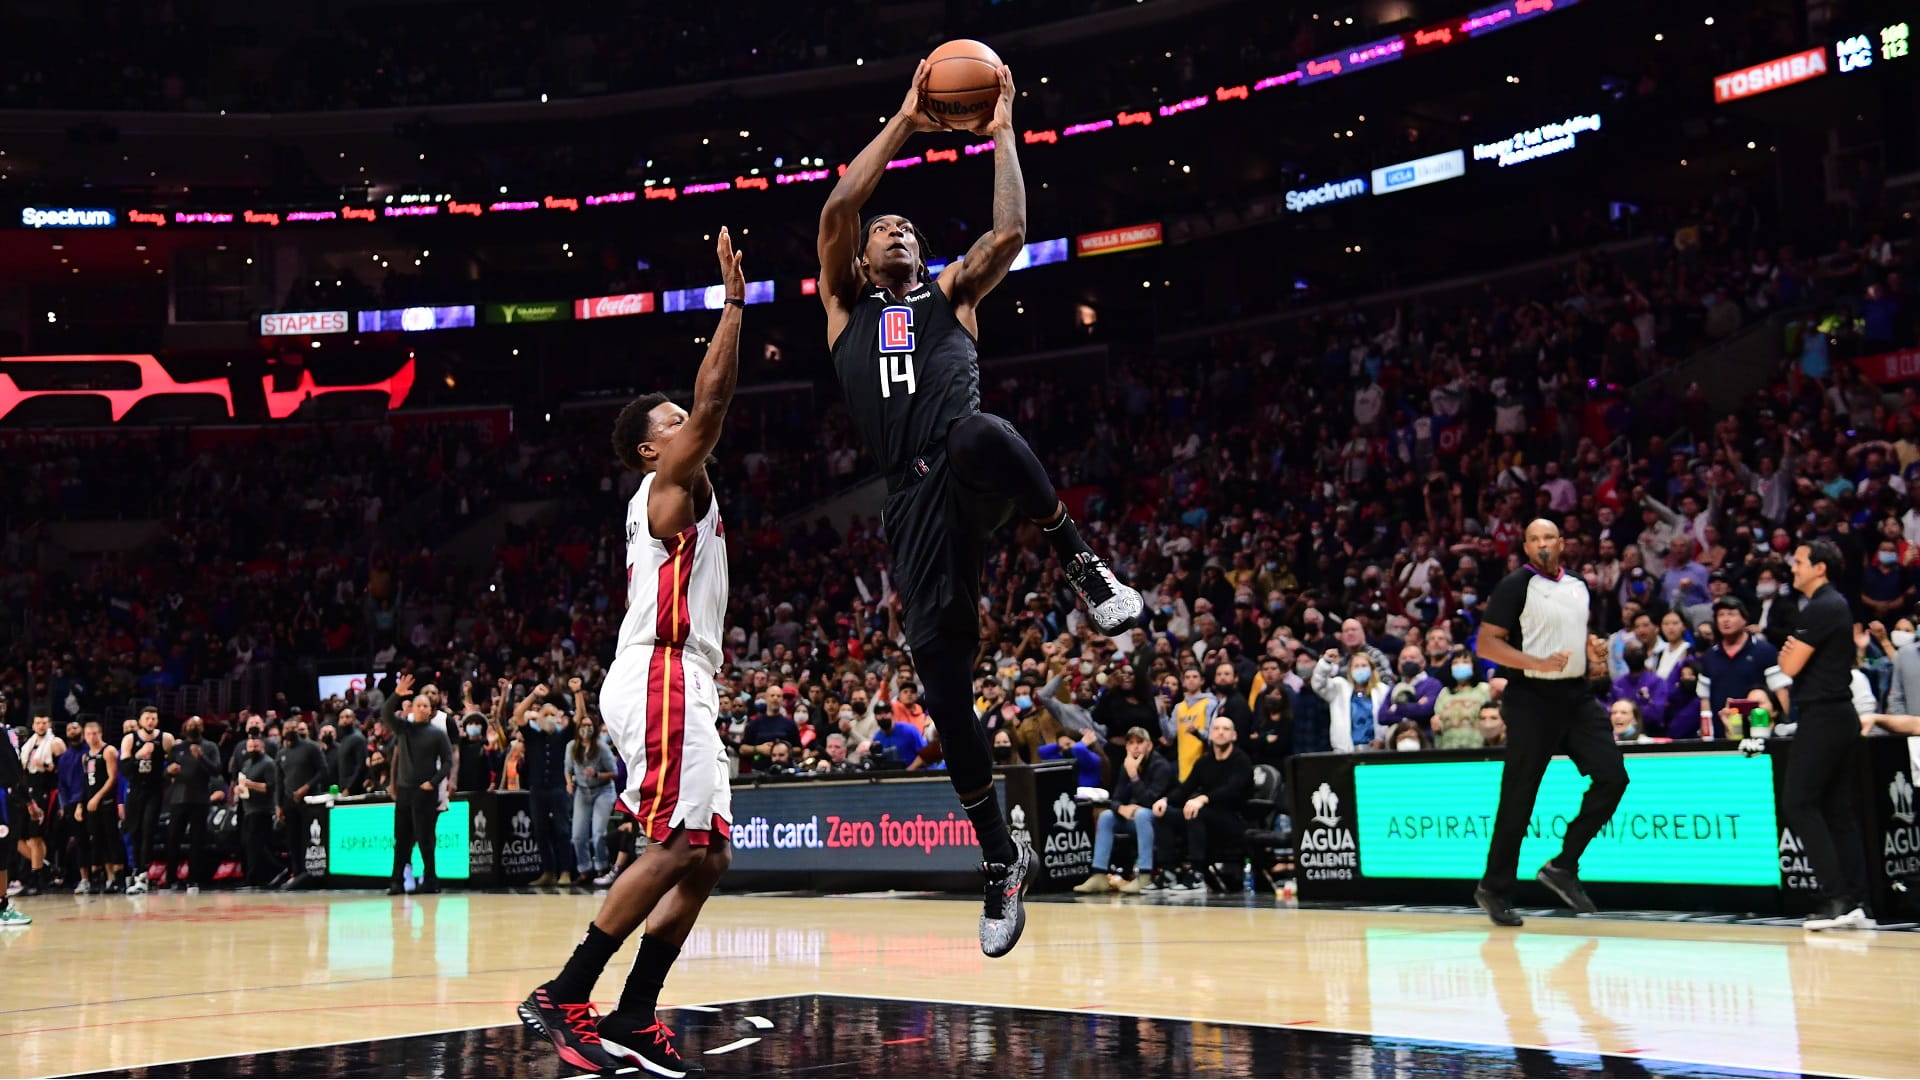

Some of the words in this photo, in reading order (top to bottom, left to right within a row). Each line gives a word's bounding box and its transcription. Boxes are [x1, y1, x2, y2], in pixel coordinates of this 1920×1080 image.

[1839, 50, 1872, 72] LAC
[1881, 39, 1908, 60] 112
[1715, 52, 1827, 98] TOSHIBA
[931, 98, 989, 115] Wilson
[1286, 178, 1364, 213] Spectrum
[22, 207, 111, 228] Spectrum
[1081, 234, 1120, 249] WELLS
[1120, 227, 1158, 243] FARGO
[264, 313, 345, 333] STAPLES
[879, 354, 916, 398] 14
[773, 815, 822, 849] card.
[826, 816, 873, 849] Zero
[1044, 831, 1092, 853] AGUA
[1300, 828, 1356, 851] AGUA
[1044, 850, 1093, 868] CALIENTE
[1300, 852, 1357, 868] CALIENTE
[1049, 865, 1090, 878] CASINOS
[1306, 868, 1352, 880] CASINOS
